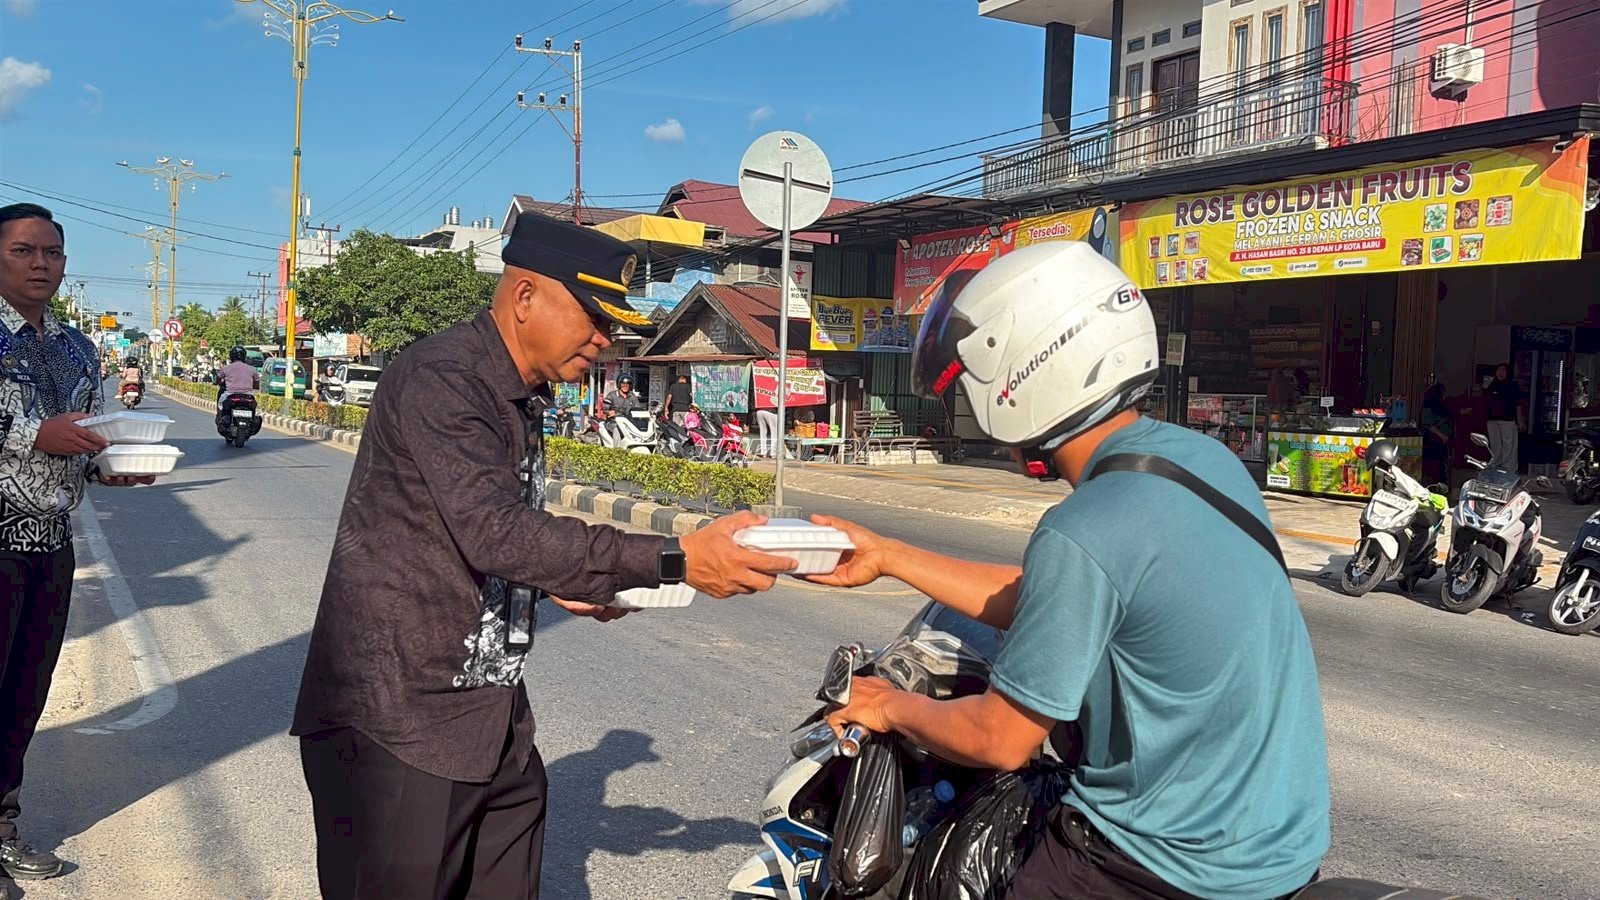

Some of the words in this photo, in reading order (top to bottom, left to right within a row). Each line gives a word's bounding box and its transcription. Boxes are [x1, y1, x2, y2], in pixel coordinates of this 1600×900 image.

[1175, 194, 1236, 228] ROSE
[1241, 178, 1354, 219] GOLDEN
[1360, 161, 1473, 206] FRUITS
[1028, 223, 1065, 240] Tersedia
[1236, 214, 1299, 239] FROZEN
[1303, 214, 1315, 232] &
[1319, 206, 1382, 230] SNACK
[912, 238, 957, 260] APOTEK
[957, 233, 991, 254] ROSE
[1233, 235, 1283, 250] MELAYANI
[1285, 232, 1327, 247] ECERAN
[1329, 231, 1337, 241] &
[1339, 227, 1382, 240] GROSIR
[1248, 251, 1268, 259] HASAN
[1269, 249, 1286, 258] BASRI
[1312, 244, 1333, 253] DEPAN
[1343, 242, 1360, 251] KOTA
[1362, 240, 1381, 249] BARU
[817, 314, 853, 325] FEVER
[996, 341, 1060, 407] evolution
[762, 805, 783, 819] HONDA
